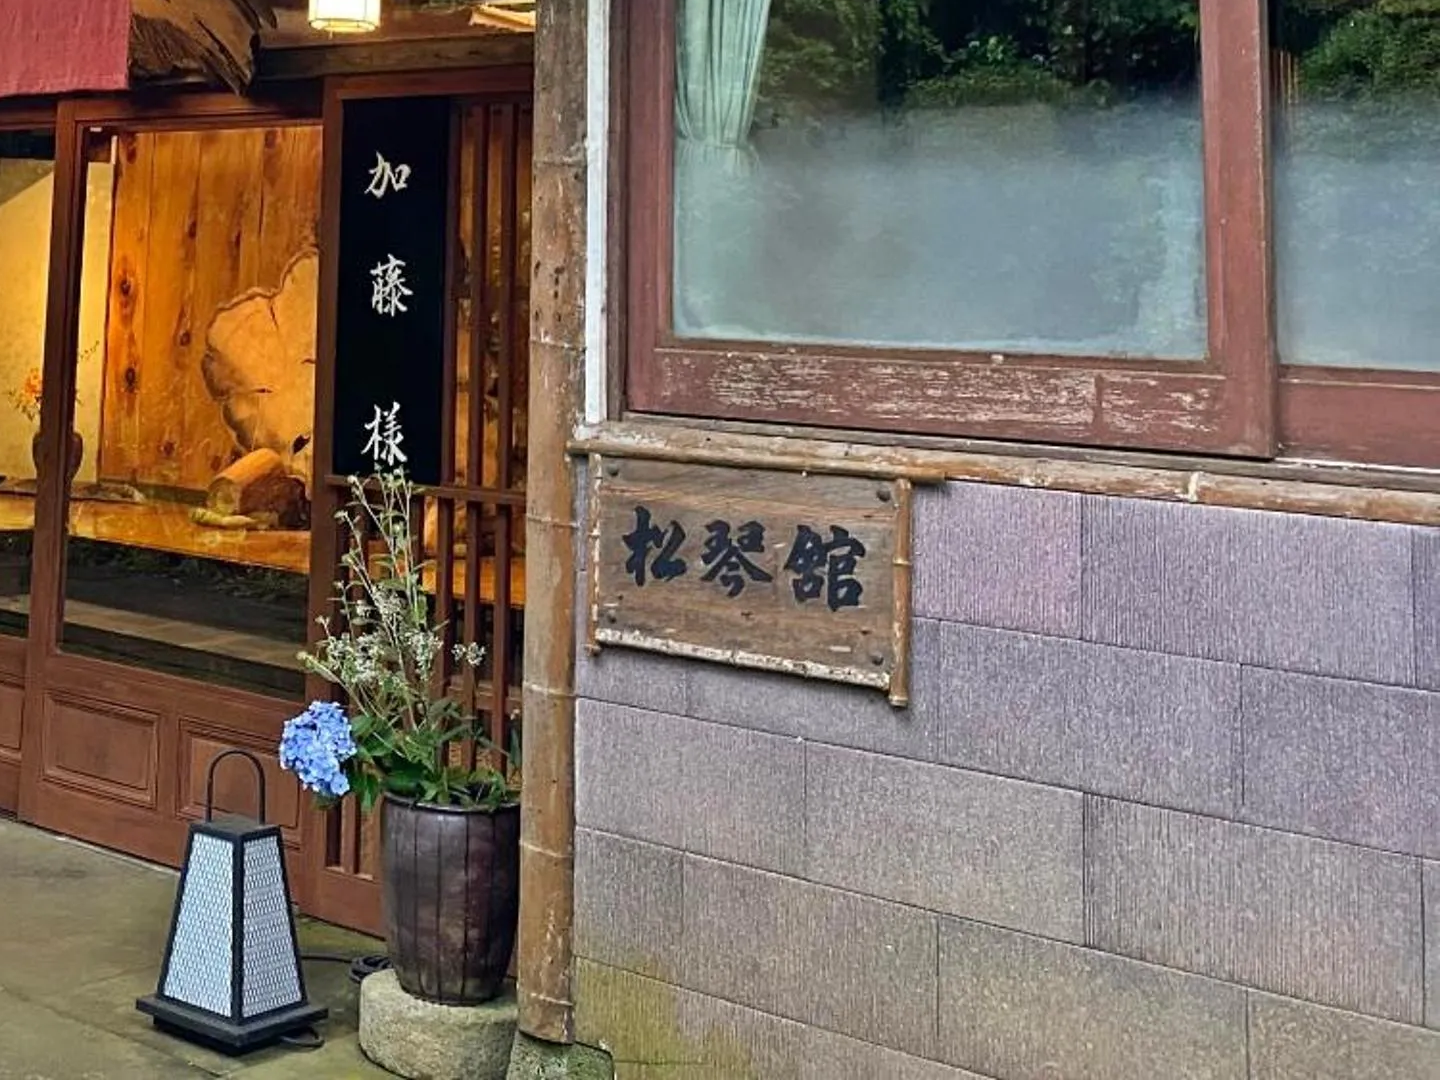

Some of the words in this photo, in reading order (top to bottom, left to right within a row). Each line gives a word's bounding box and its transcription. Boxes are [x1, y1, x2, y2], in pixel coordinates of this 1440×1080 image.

[361, 150, 414, 466] 加藤様
[622, 505, 866, 612] 松琴館
